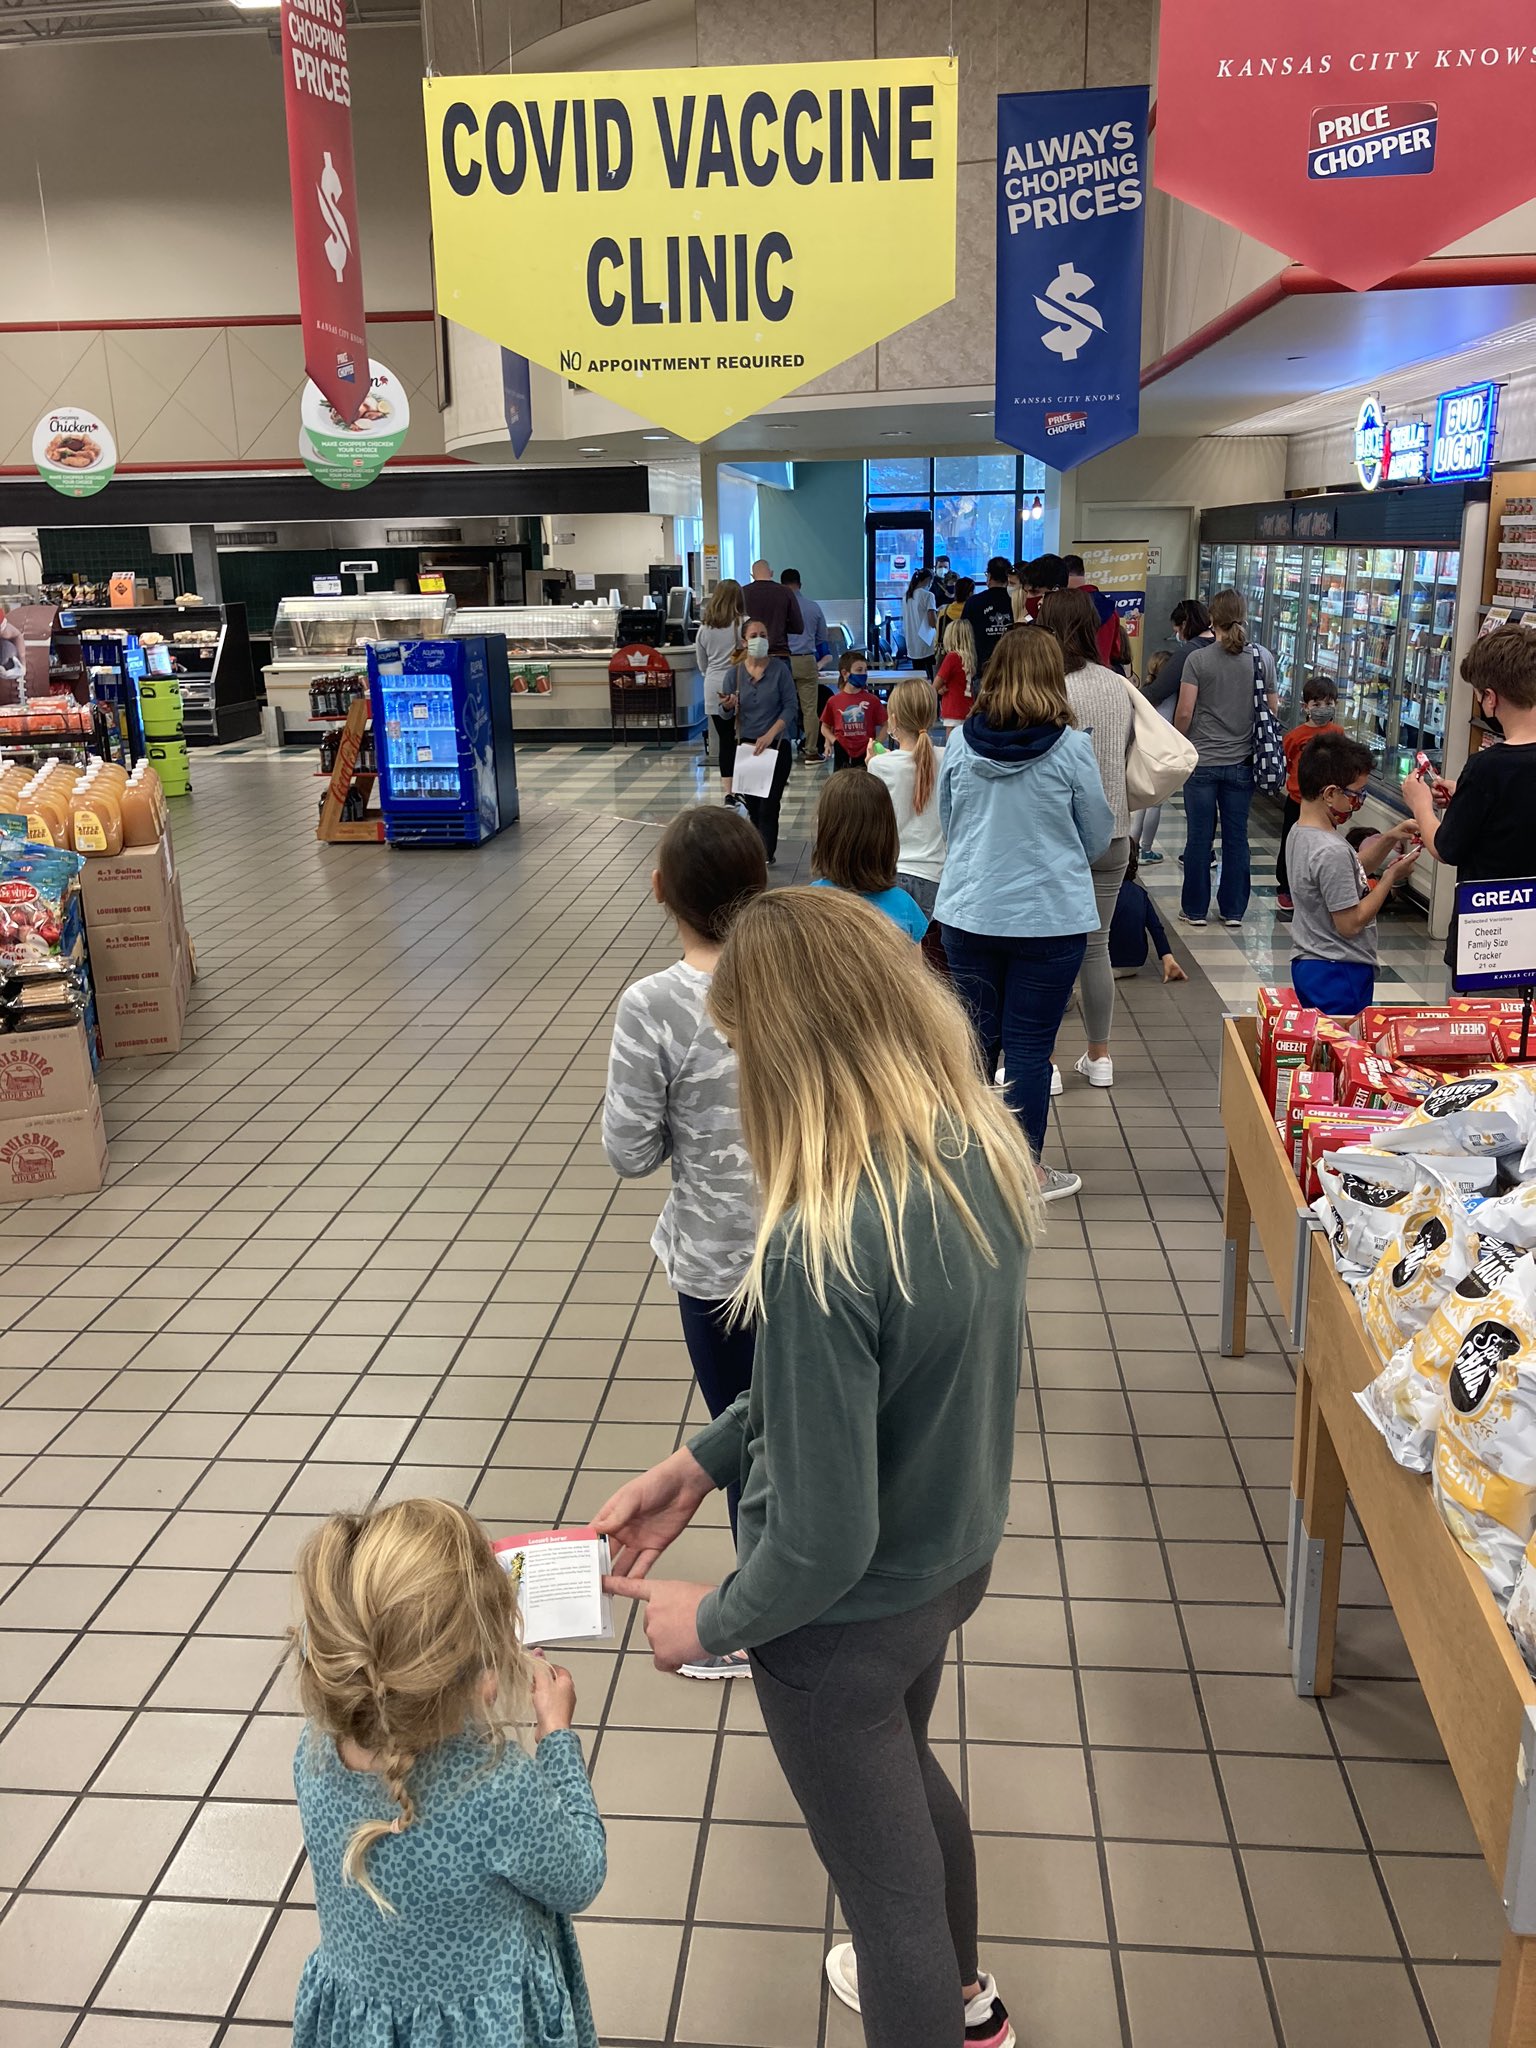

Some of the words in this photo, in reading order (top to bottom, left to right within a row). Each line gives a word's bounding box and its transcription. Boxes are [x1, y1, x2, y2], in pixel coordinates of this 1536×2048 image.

[288, 11, 348, 62] CHOPPING
[1216, 55, 1332, 79] KANSAS
[1348, 51, 1420, 73] CITY
[292, 47, 352, 108] PRICES
[1317, 105, 1391, 145] PRICE
[441, 97, 634, 197] COVID
[652, 84, 935, 189] VACCINE
[1003, 121, 1135, 176] ALWAYS
[1312, 128, 1432, 177] CHOPPER
[1004, 152, 1139, 200] CHOPPING
[1007, 178, 1143, 235] PRICES
[585, 231, 795, 327] CLINIC
[560, 350, 582, 372] NO
[587, 357, 711, 373] APPOINTMENT
[716, 354, 805, 370] REQUIRED
[1014, 396, 1053, 405] KANSAS
[1057, 395, 1081, 403] CITY
[1084, 394, 1121, 402] KNOWS
[1047, 413, 1072, 426] PRICE
[1445, 394, 1484, 436] BUD
[49, 420, 93, 433] Chicken
[1046, 420, 1086, 436] CHOPPER
[1435, 430, 1487, 473] LIGHT
[1082, 549, 1112, 559] GOT
[1099, 552, 1144, 564] SHOT!
[1099, 573, 1144, 585] SHOT!
[1471, 888, 1534, 908] GREAT
[97, 907, 132, 915] LOUISBURG
[123, 935, 150, 943] Gallon
[1474, 927, 1502, 937] Cheezit
[1467, 940, 1492, 950] Family
[1493, 938, 1508, 947] Size
[1473, 951, 1502, 961] Cracker
[105, 974, 140, 982] LOUISBURG
[132, 1001, 159, 1009] Gallon
[1449, 1022, 1487, 1036] CHEEZ-IT
[114, 1040, 148, 1048] LOUISBURG
[1275, 1040, 1308, 1053] CHEEZ-IT
[1432, 1083, 1493, 1099] CHAOS
[1426, 1092, 1479, 1114] Sweet
[1307, 1109, 1351, 1119] CHEEZ-IT
[0, 1132, 65, 1165] LOUISBURG
[12, 1173, 37, 1184] CIDER
[38, 1170, 57, 1180] MILL
[1472, 1254, 1511, 1291] HAOS
[1438, 1443, 1487, 1504] CORN
